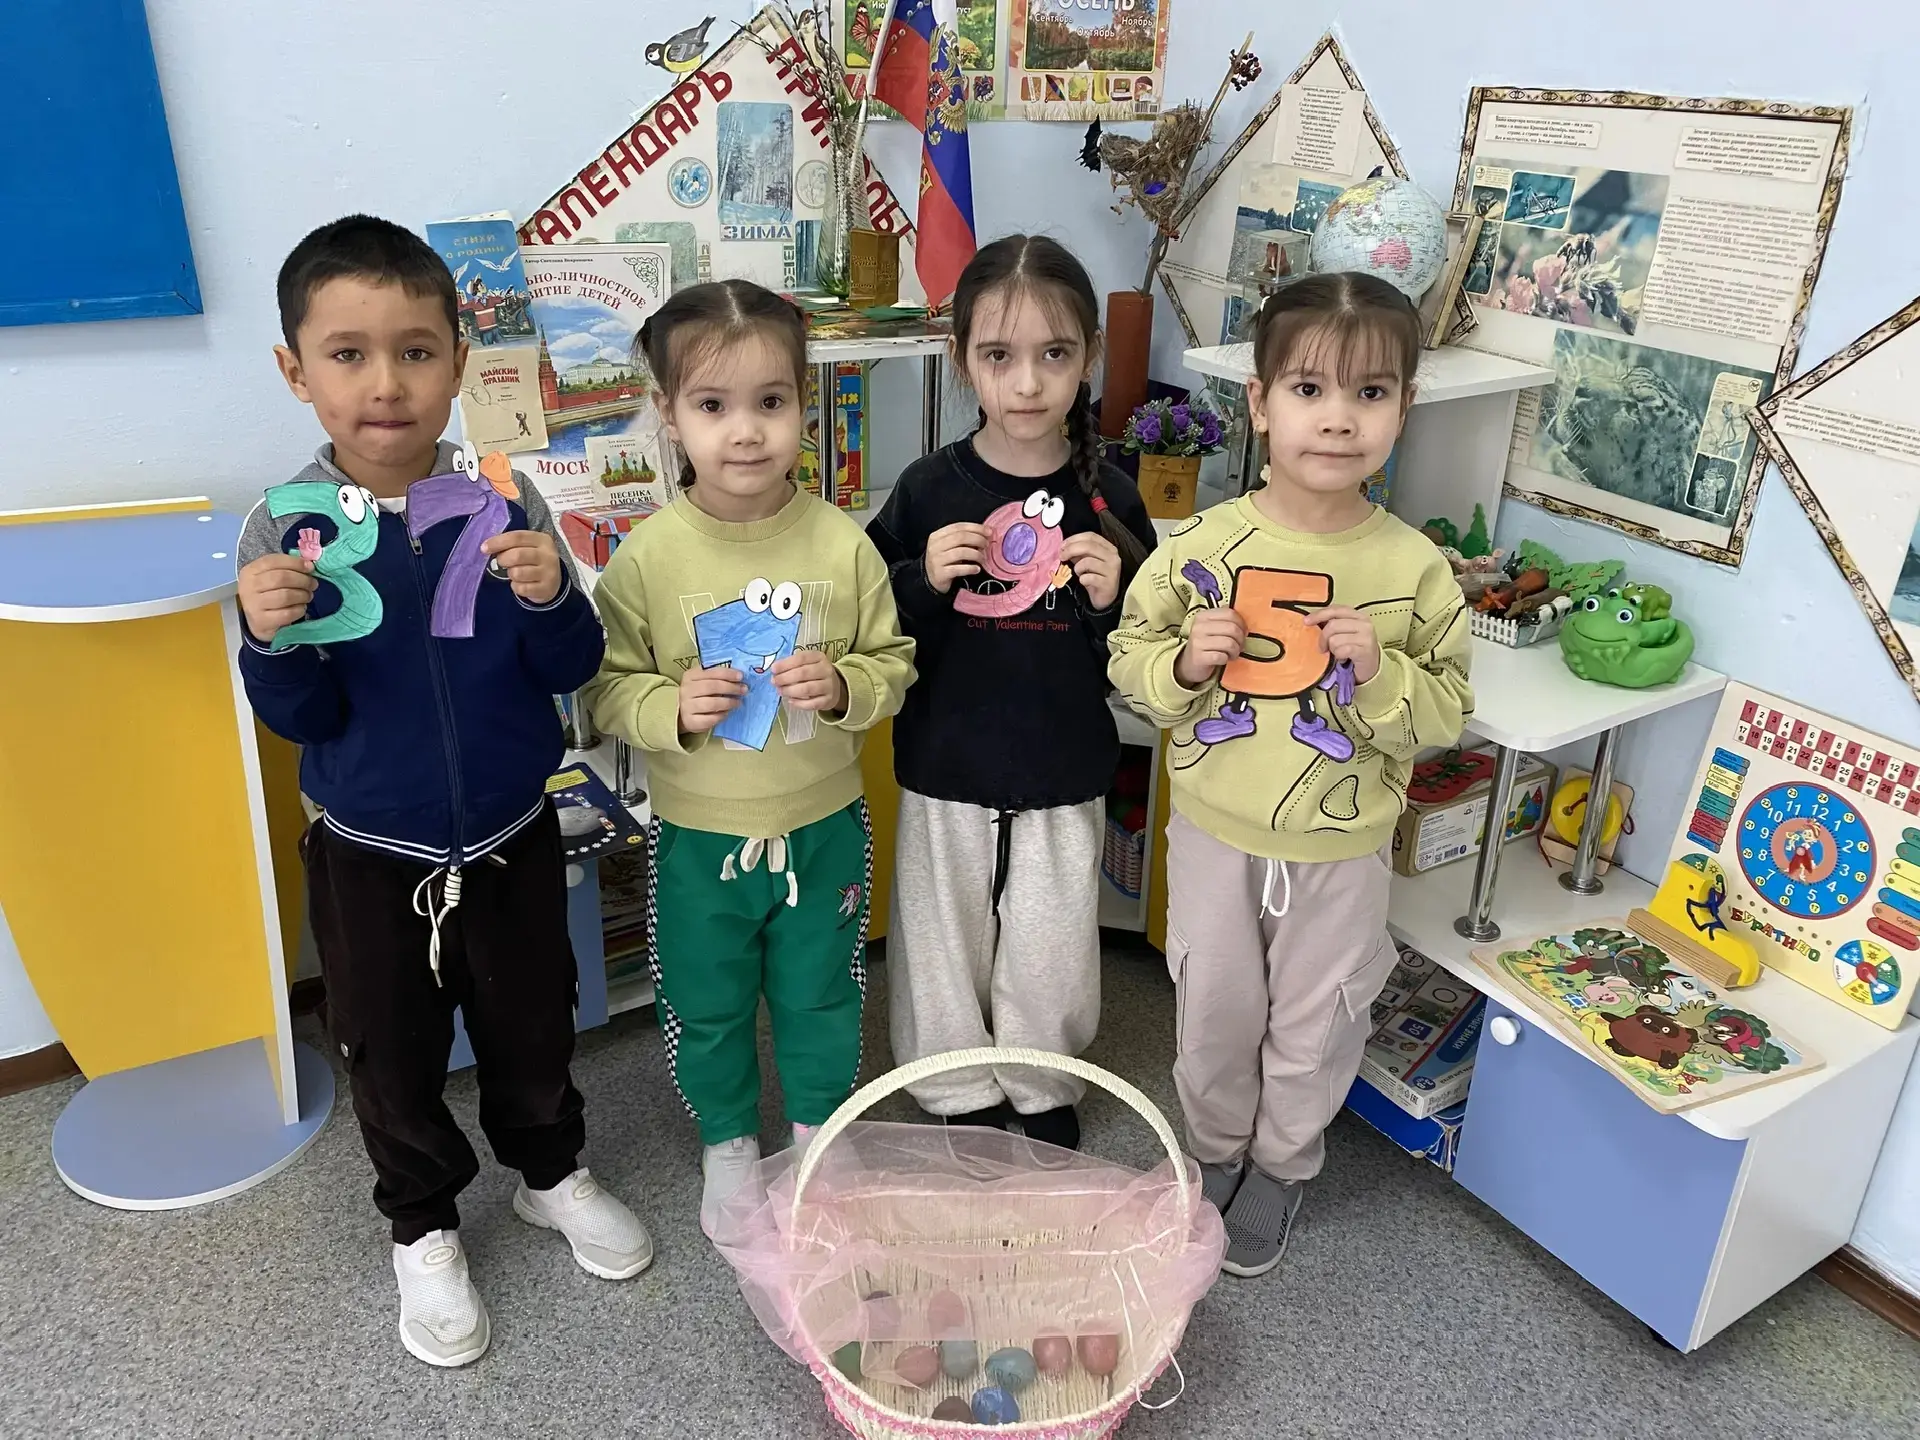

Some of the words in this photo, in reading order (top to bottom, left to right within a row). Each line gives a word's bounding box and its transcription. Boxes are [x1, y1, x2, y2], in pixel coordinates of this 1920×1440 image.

[1035, 12, 1073, 23] Сентябрь
[1121, 17, 1153, 26] Ноябрь
[1076, 26, 1115, 38] Октябрь
[723, 225, 792, 240] ЗИМА
[526, 272, 647, 309] ЬНО-ЛИЧНОСТНОЕ
[577, 286, 622, 310] ДЕТЕЙ
[480, 366, 519, 379] МАЙСКИЙ
[536, 459, 590, 476] МОСК
[610, 489, 652, 500] ПЕСЕНКА
[618, 496, 655, 505] МОСКВЕ
[967, 618, 988, 628] Cut
[994, 619, 1044, 631] Valentine
[1046, 621, 1072, 632] Font
[1219, 566, 1333, 699] 5
[1758, 711, 1766, 719] 2
[1783, 721, 1790, 729] 4
[1809, 731, 1815, 739] 6
[1823, 736, 1829, 744] 7
[1861, 752, 1872, 761] 10
[1876, 758, 1886, 766] 11
[1889, 763, 1901, 773] 12
[1903, 769, 1915, 778] 13
[1738, 725, 1748, 733] 17
[1751, 731, 1760, 739] 18
[1763, 736, 1772, 744] 19
[1775, 741, 1785, 749] 20
[1787, 746, 1797, 755] 21
[1800, 751, 1811, 760] 22
[1812, 756, 1824, 765] 23
[1825, 761, 1837, 770] 24
[1838, 766, 1850, 776] 25
[1852, 772, 1864, 782] 26
[1866, 778, 1878, 787] 27
[1880, 784, 1892, 794] 28
[1894, 790, 1906, 800] 29
[1909, 795, 1920, 805] 30
[1786, 800, 1802, 816] 11
[1811, 804, 1830, 820] 12
[1767, 807, 1784, 823] 10
[1834, 820, 1842, 832] 1
[1760, 827, 1770, 840] 9
[1842, 840, 1854, 853] 2
[1758, 849, 1768, 861] 8
[1766, 869, 1776, 881] 7
[1840, 864, 1850, 877] 3
[1784, 884, 1795, 896] 6
[1826, 881, 1838, 893] 4
[1807, 889, 1818, 901] 5
[1810, 903, 1819, 912] 17
[1731, 907, 1821, 962] БУРАТИНО
